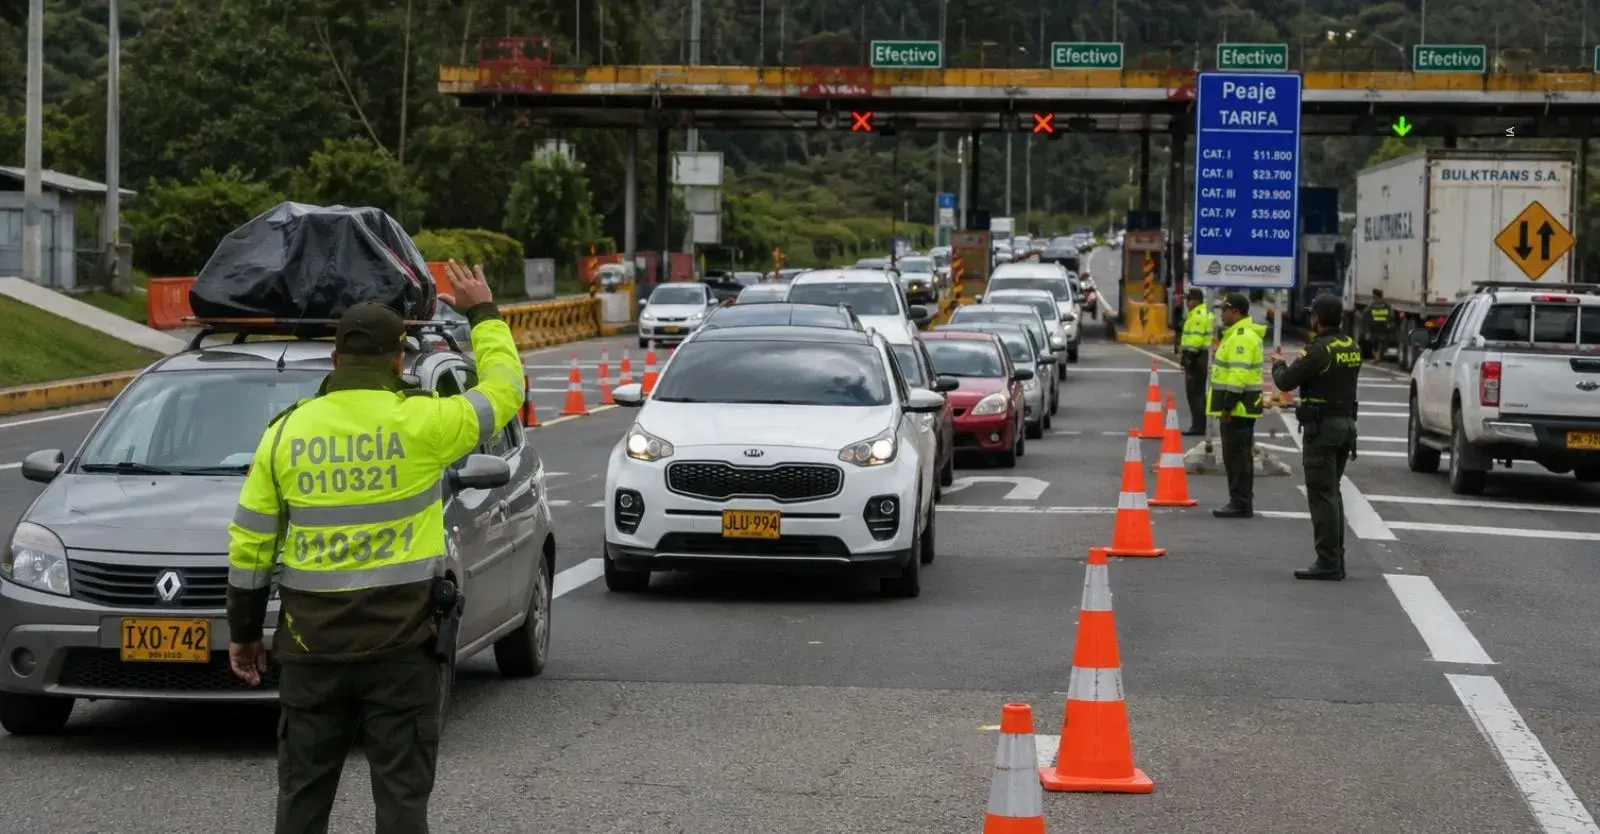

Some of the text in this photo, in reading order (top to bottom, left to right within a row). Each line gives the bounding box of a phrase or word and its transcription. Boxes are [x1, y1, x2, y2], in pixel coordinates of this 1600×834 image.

[875, 46, 936, 62] Efectivo
[1056, 47, 1118, 64] Efectivo
[1221, 50, 1283, 65] Efectivo
[1418, 50, 1481, 66] Efectivo
[1223, 81, 1276, 103] Peaje
[1219, 110, 1278, 126] TARIFA
[1203, 149, 1292, 160] CAT. I $11.800
[1202, 168, 1292, 180] CAT. II $23.700
[1441, 169, 1560, 181] BULKTRANS S.A.
[1201, 188, 1291, 200] CAT. III $29.900
[1201, 208, 1291, 219] CAT. IV $35.600
[1200, 227, 1290, 239] CAT. V $41.700
[1224, 264, 1281, 273] COVIANDES
[290, 425, 405, 467] POLICÍA
[745, 448, 763, 457] KIA
[297, 464, 398, 495] 010321
[294, 522, 414, 564] 010321
